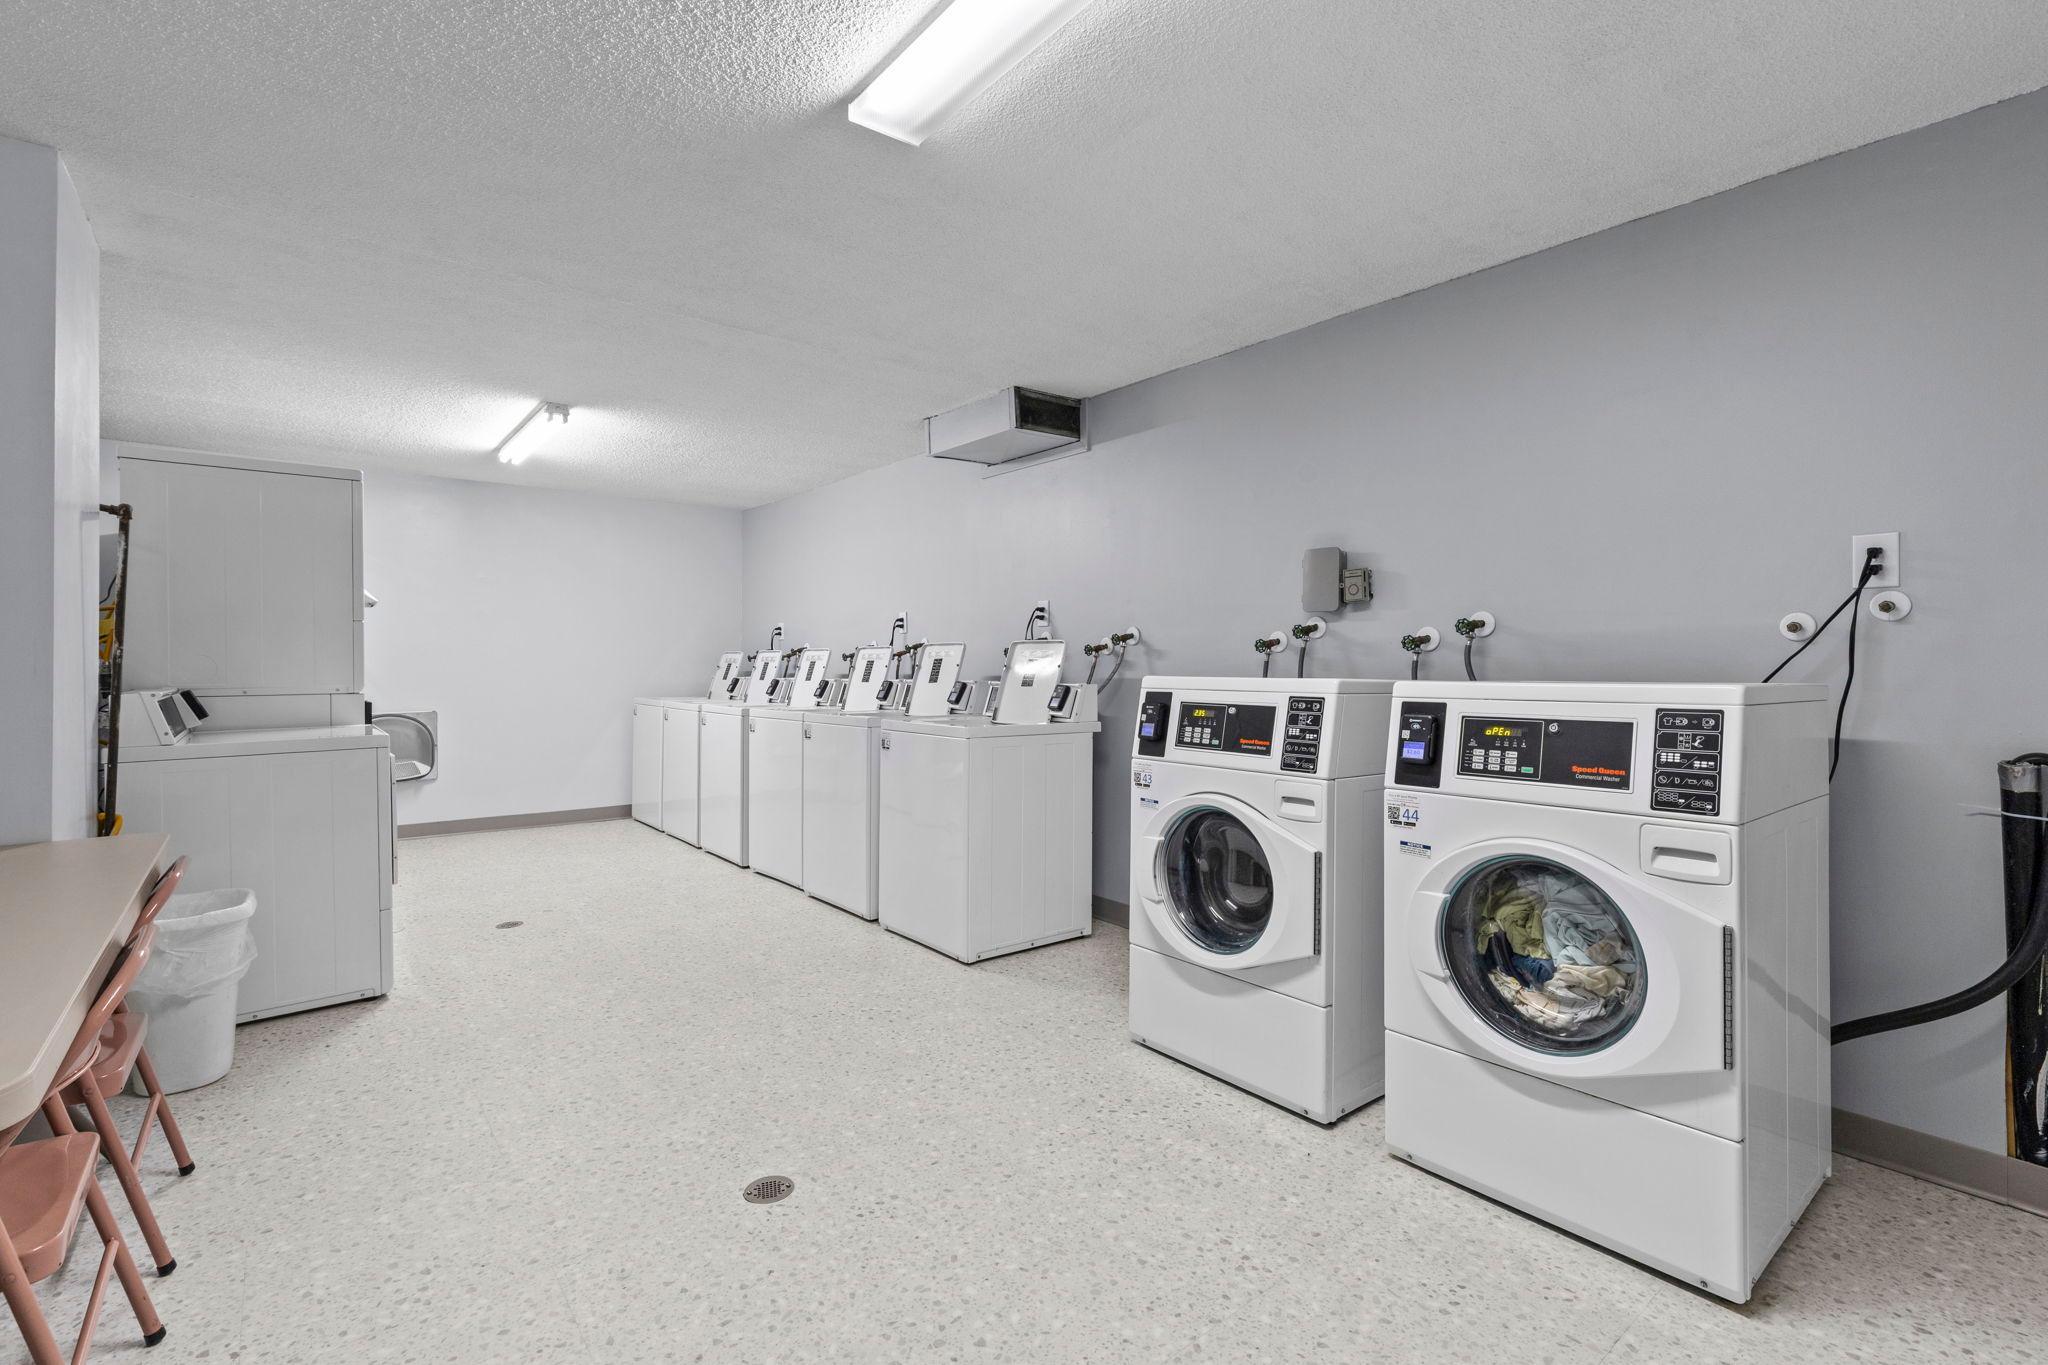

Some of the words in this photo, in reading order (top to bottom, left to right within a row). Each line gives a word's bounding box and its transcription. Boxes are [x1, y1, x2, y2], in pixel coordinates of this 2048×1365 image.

[1572, 765, 1598, 774] Speed
[1598, 767, 1626, 776] Queen
[1142, 773, 1153, 784] 43
[1575, 773, 1603, 781] Commercial
[1402, 808, 1420, 822] 44
